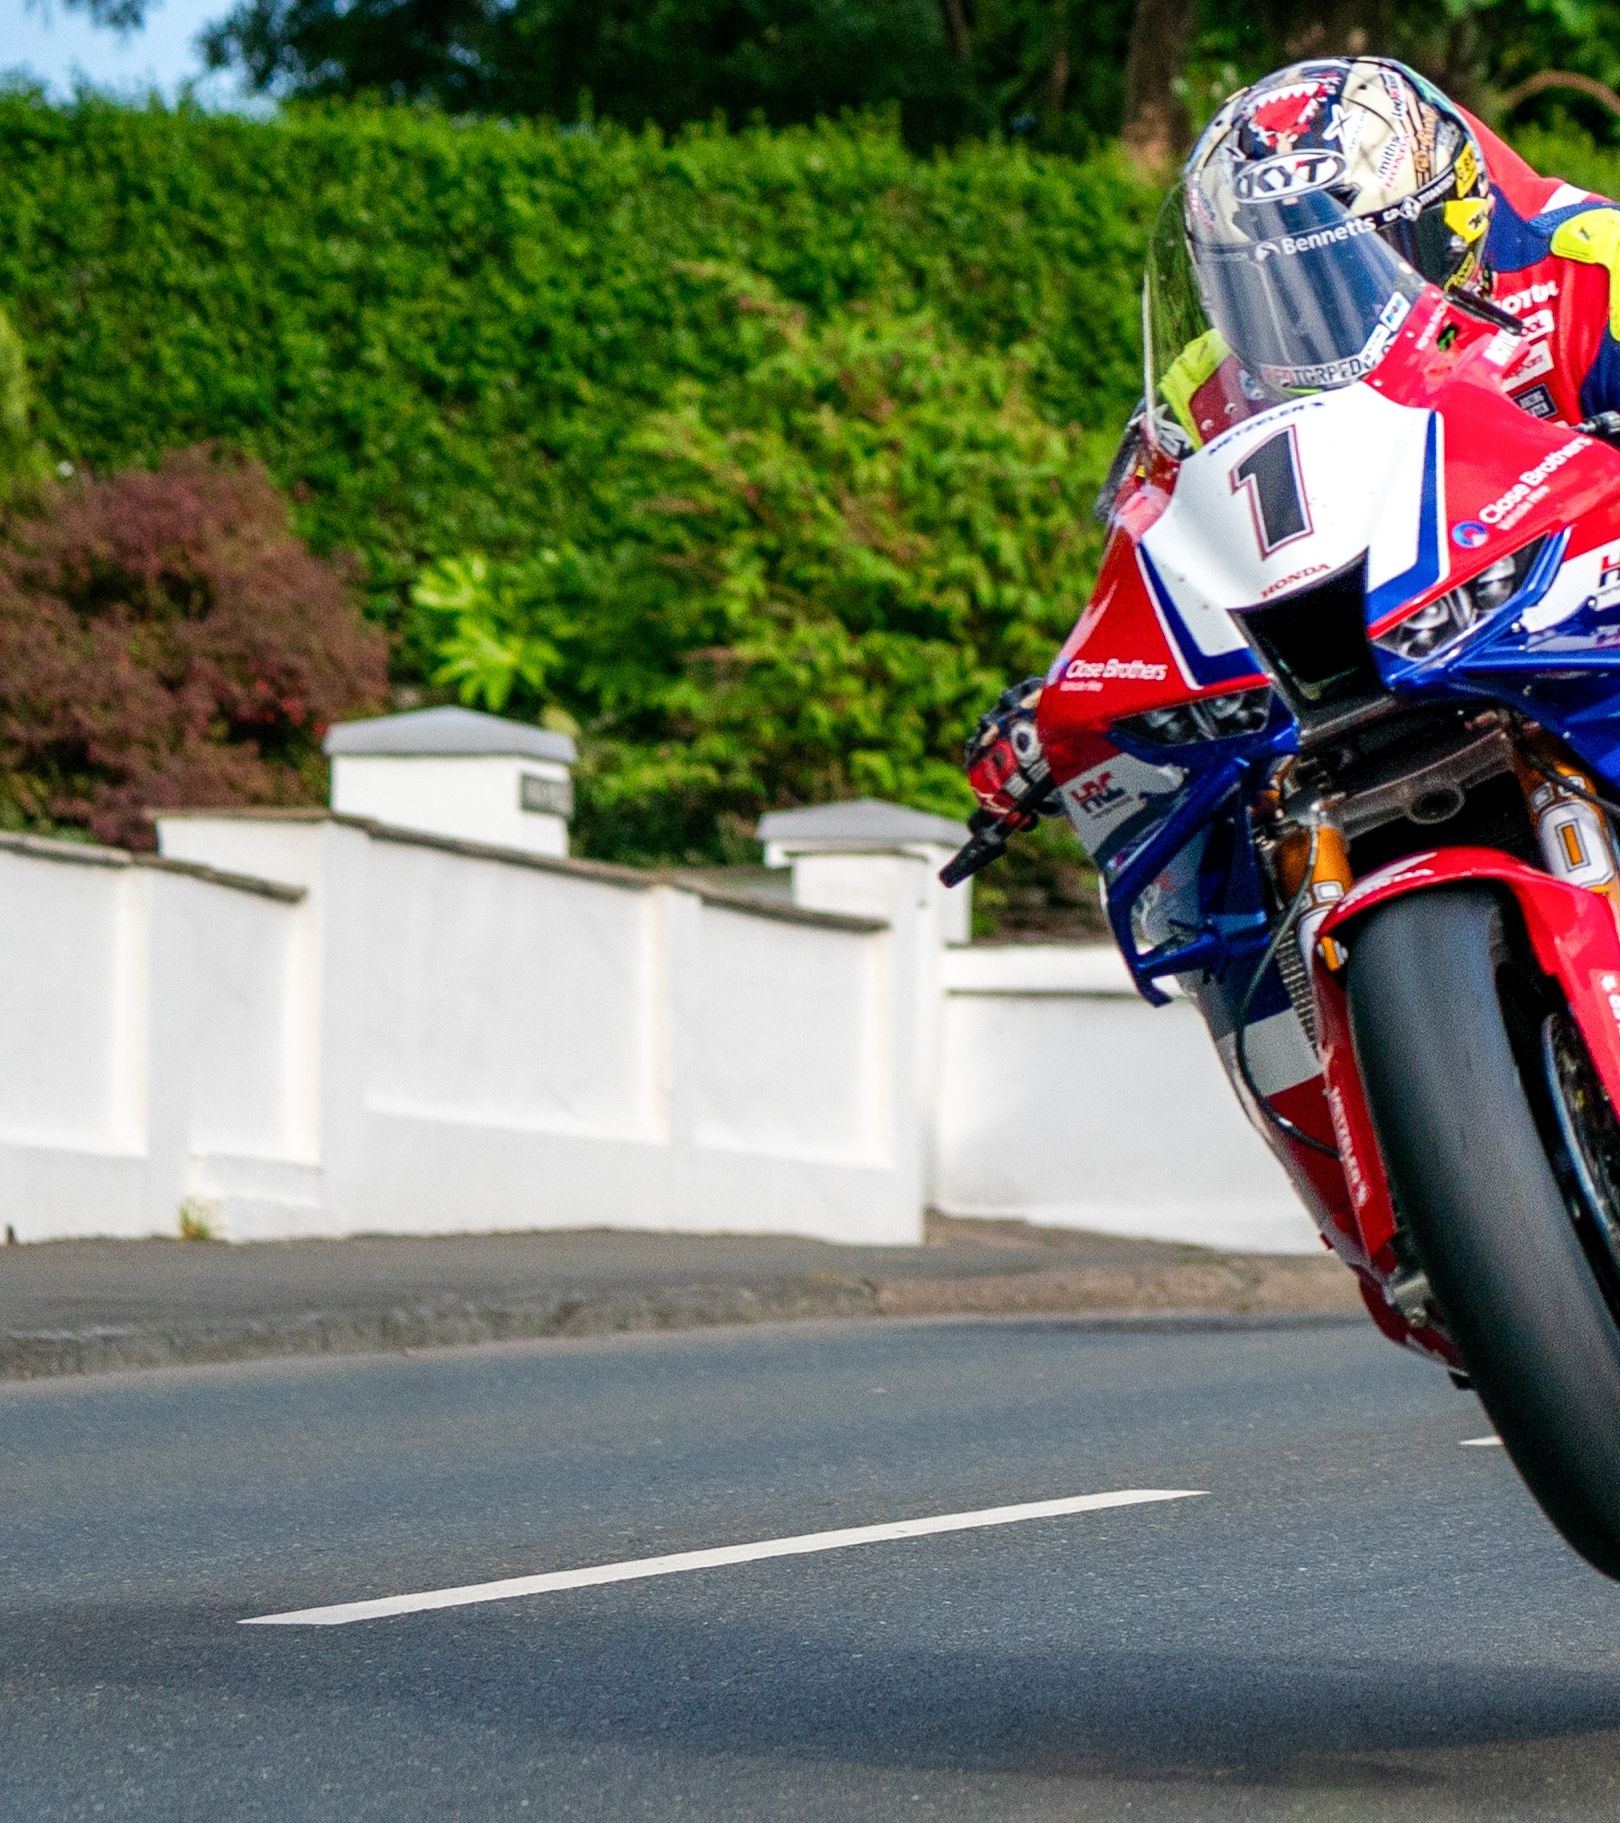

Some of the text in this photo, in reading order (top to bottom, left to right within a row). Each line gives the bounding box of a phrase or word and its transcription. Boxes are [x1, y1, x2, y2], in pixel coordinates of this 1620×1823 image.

[1236, 155, 1331, 198] KYT
[1281, 215, 1376, 256] Bennetts
[1208, 405, 1305, 455] METZELER
[1228, 423, 1315, 561] 1
[1479, 436, 1593, 524] Close Brothers
[1261, 563, 1331, 598] HONDA
[1066, 658, 1169, 681] Close Brothers
[1070, 770, 1127, 814] HRC
